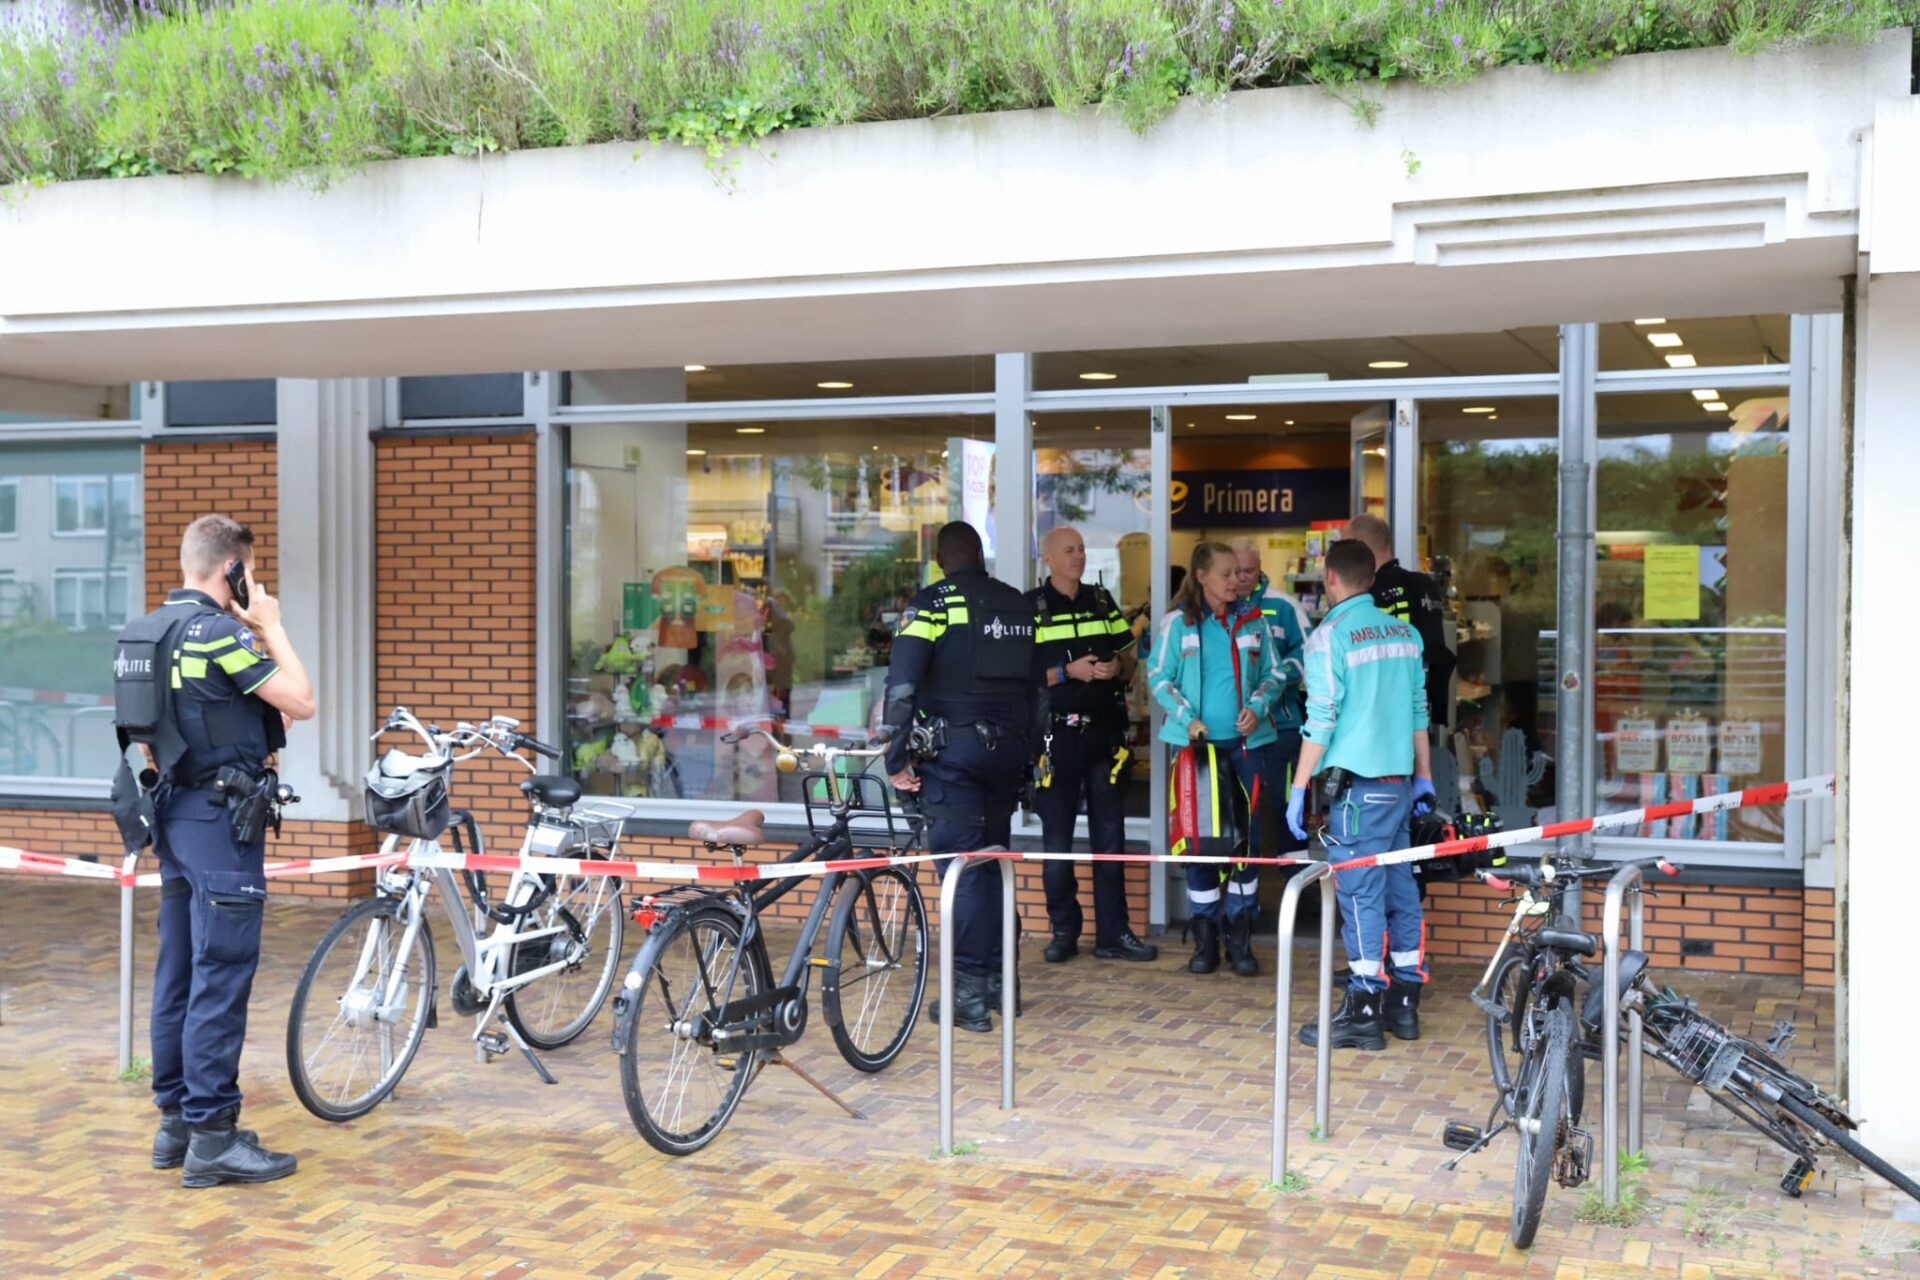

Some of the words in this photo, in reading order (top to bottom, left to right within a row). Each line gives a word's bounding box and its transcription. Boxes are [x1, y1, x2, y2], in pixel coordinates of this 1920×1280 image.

[1204, 483, 1293, 513] Primera
[984, 616, 1033, 639] POLITIE
[1350, 624, 1412, 644] AMBULANCE
[1724, 735, 1756, 744] BESTE
